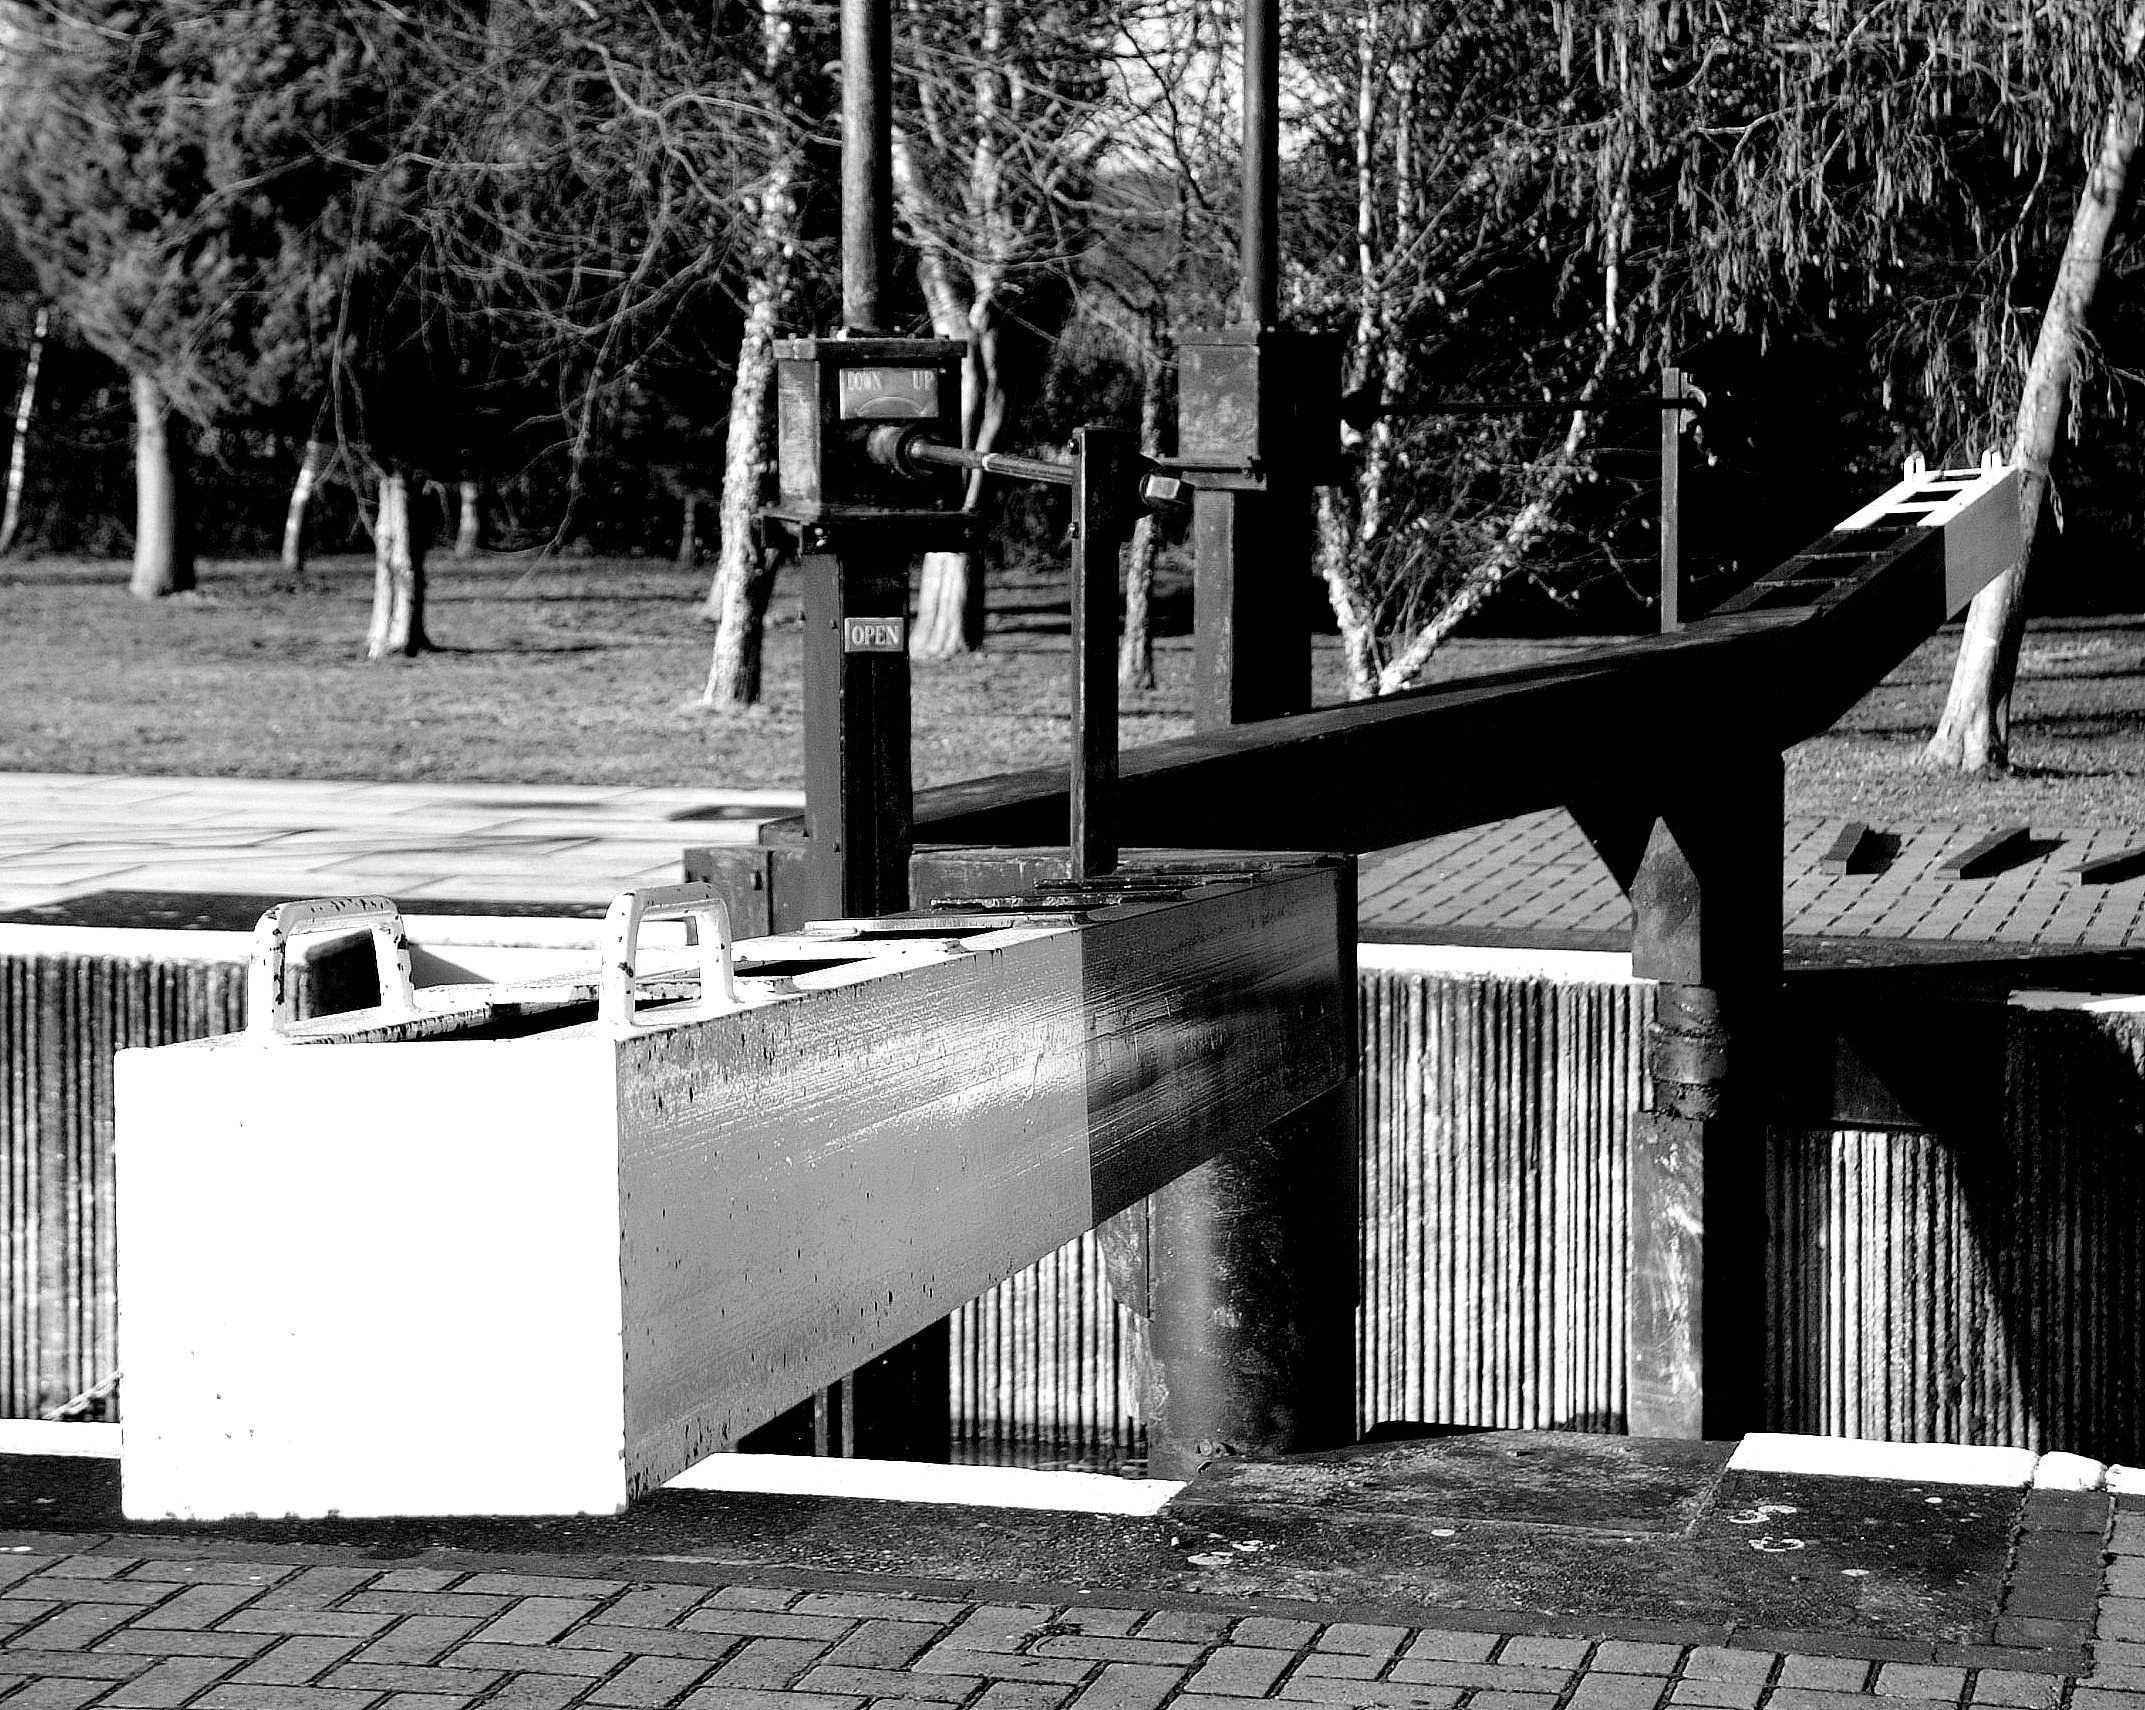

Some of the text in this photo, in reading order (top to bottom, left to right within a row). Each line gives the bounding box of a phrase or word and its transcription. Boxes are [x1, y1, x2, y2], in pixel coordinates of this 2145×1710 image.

[847, 370, 936, 391] DOWN UP
[851, 624, 900, 646] OPEN
